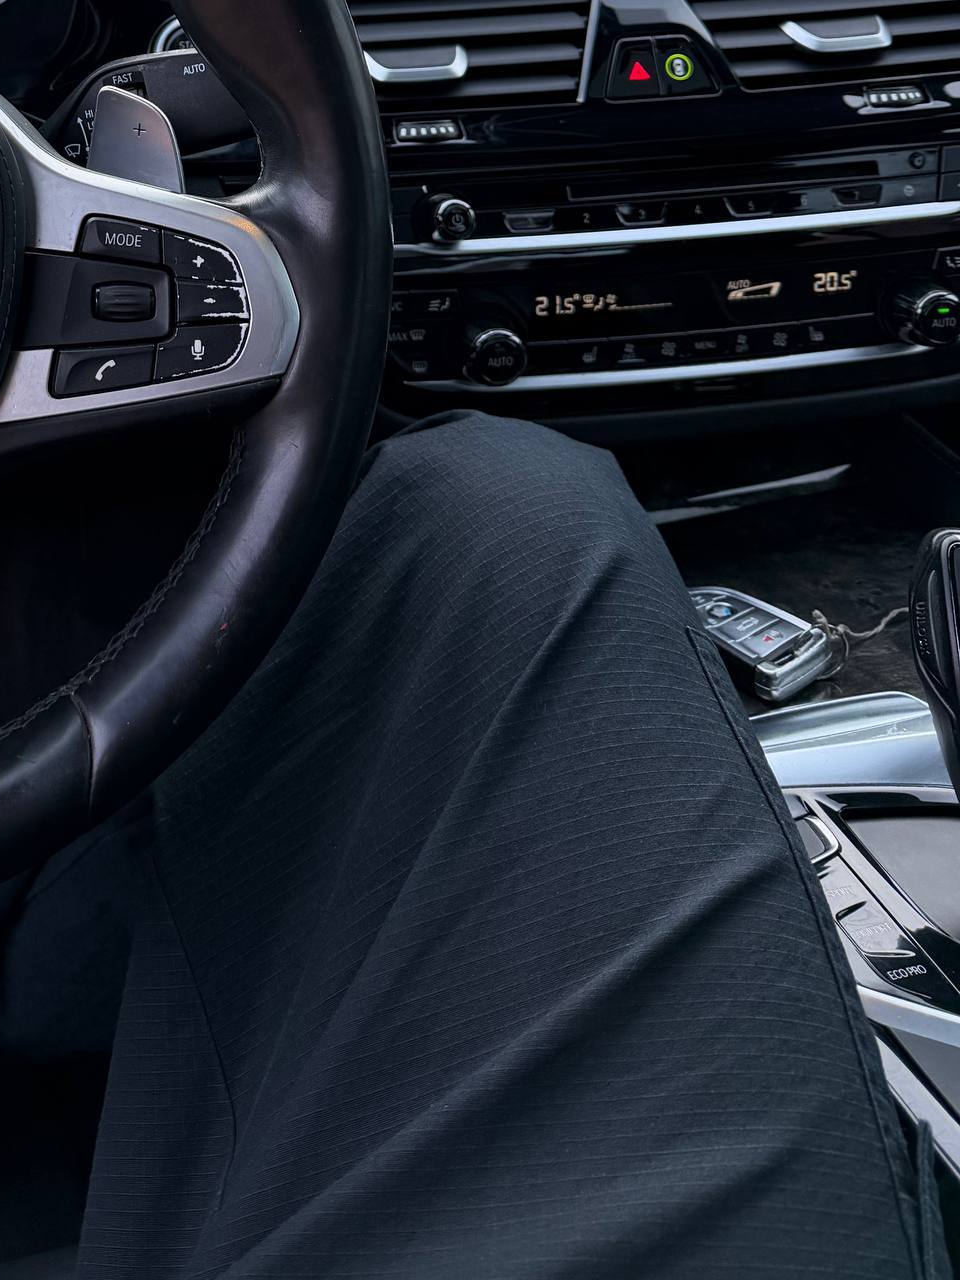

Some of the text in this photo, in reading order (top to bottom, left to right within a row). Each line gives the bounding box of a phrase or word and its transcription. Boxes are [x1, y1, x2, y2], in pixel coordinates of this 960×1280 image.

[183, 63, 205, 75] AUTO
[112, 73, 133, 85] FAST
[582, 212, 590, 224] 2
[105, 232, 142, 248] MODE
[727, 279, 750, 290] AUTO
[931, 317, 957, 328] AUTO
[488, 356, 513, 368] AUTO
[887, 964, 927, 981] ECO PRO
